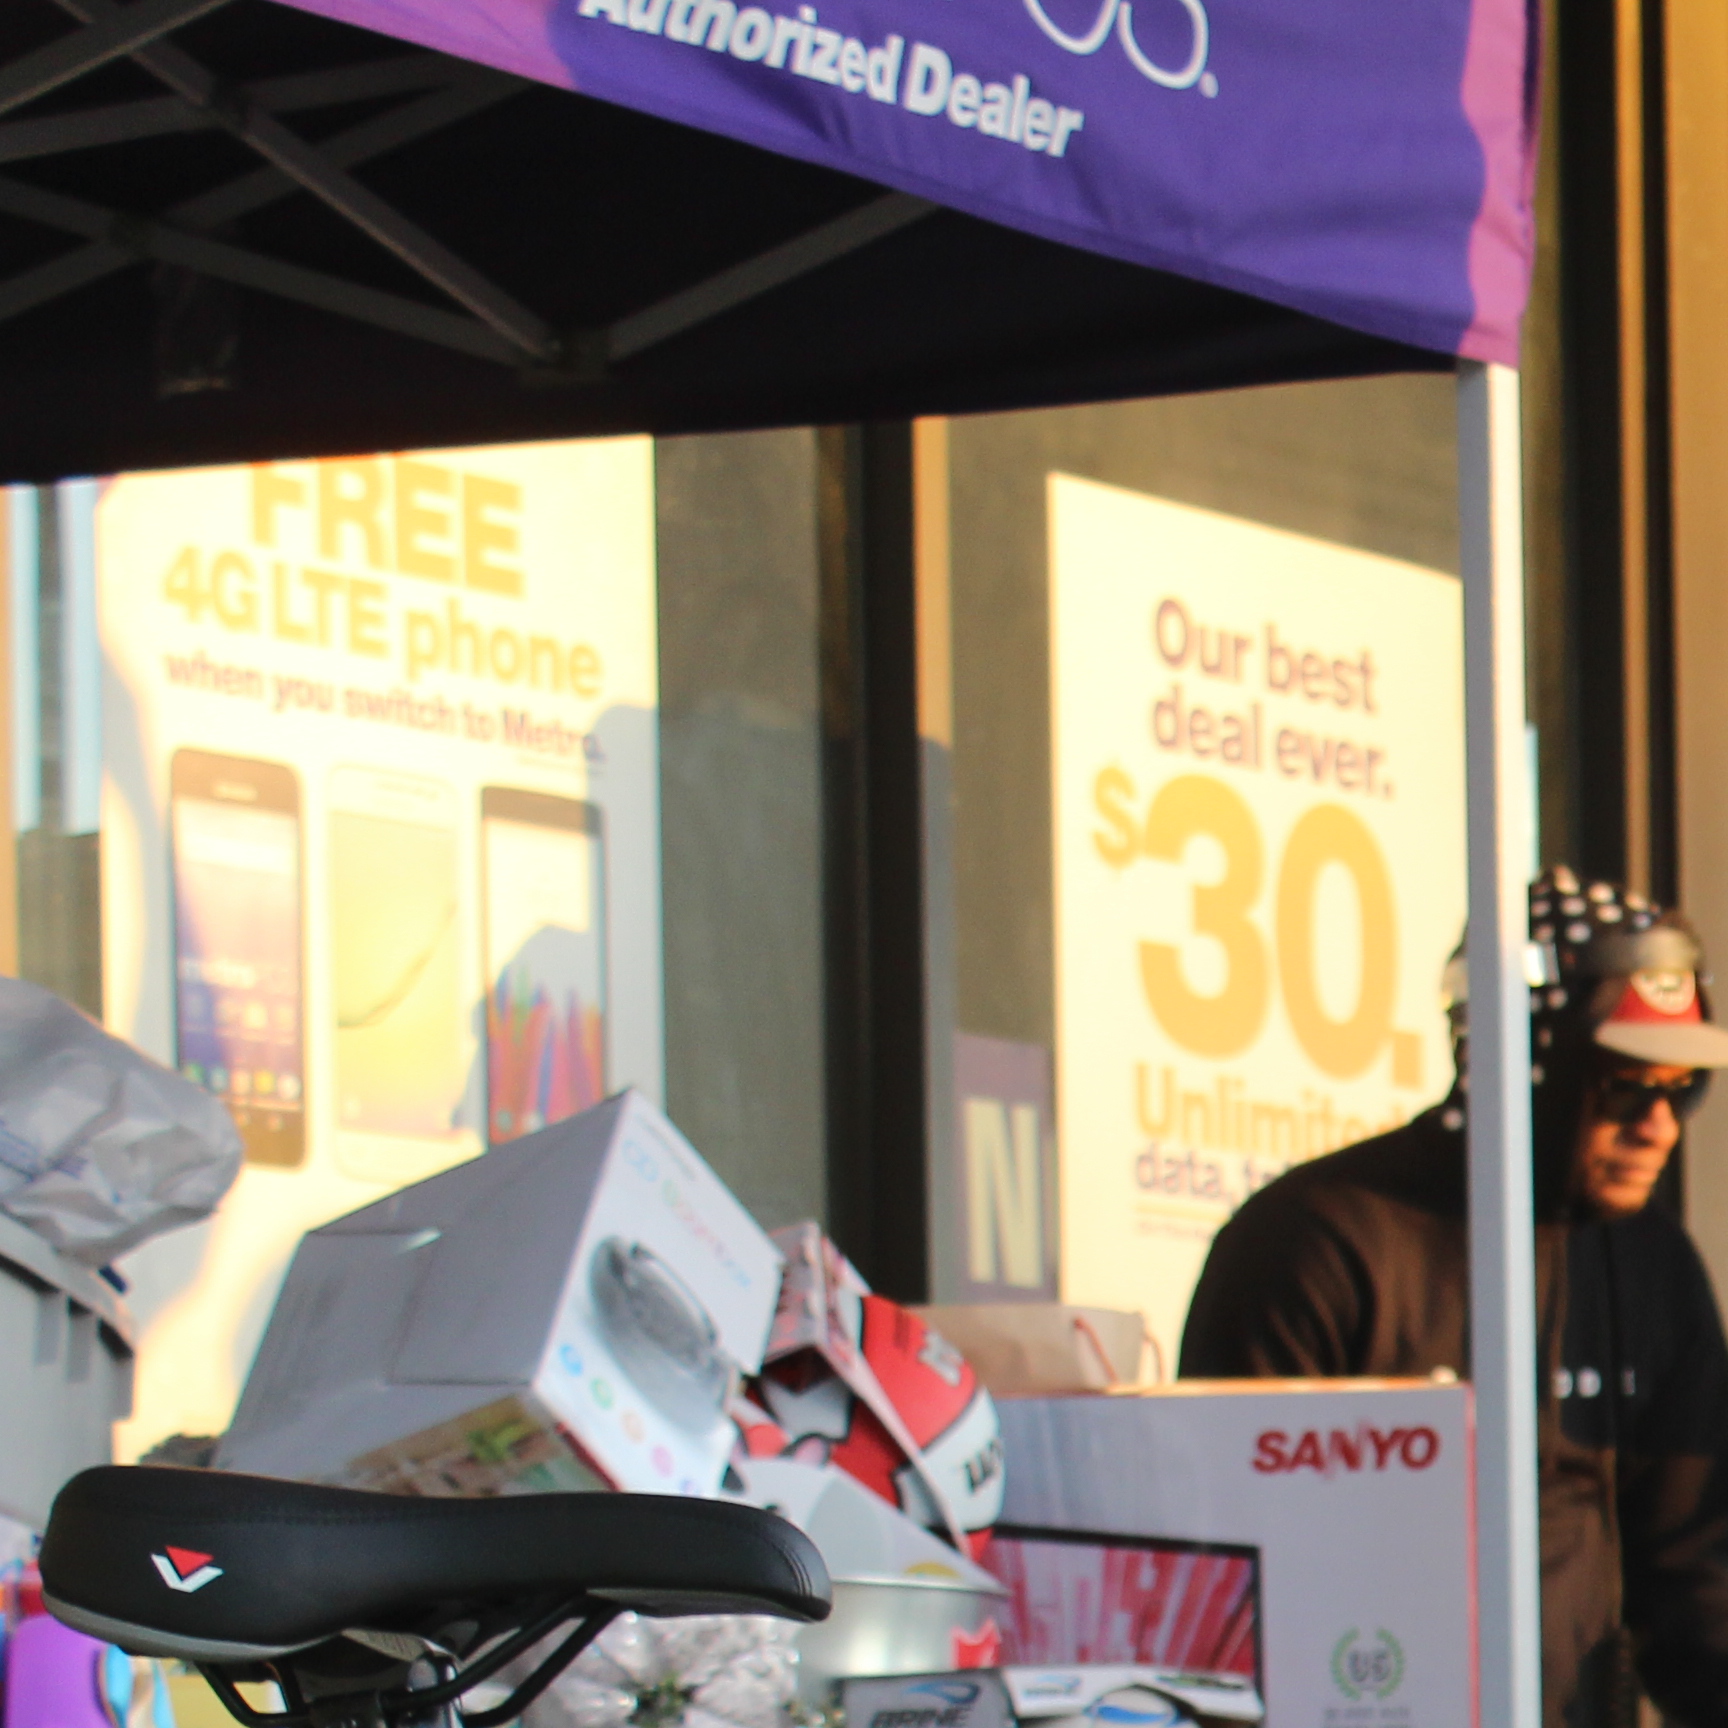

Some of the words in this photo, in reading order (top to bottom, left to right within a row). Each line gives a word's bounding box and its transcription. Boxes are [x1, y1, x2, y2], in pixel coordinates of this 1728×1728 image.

[902, 43, 1085, 157] Dealer
[250, 457, 526, 597] FREE
[163, 545, 260, 633] 4G
[273, 559, 390, 658] LTE
[404, 597, 603, 698] phone
[1153, 596, 1256, 686] Our
[1265, 618, 1379, 716] best
[165, 651, 265, 699] when
[273, 673, 335, 712] you
[345, 685, 456, 734] switch
[463, 703, 498, 742] to
[1151, 683, 1261, 772] deal
[1275, 722, 1396, 801] ever.
[1136, 1061, 1408, 1162] Unlimite
[1252, 1425, 1440, 1473] SANYO
